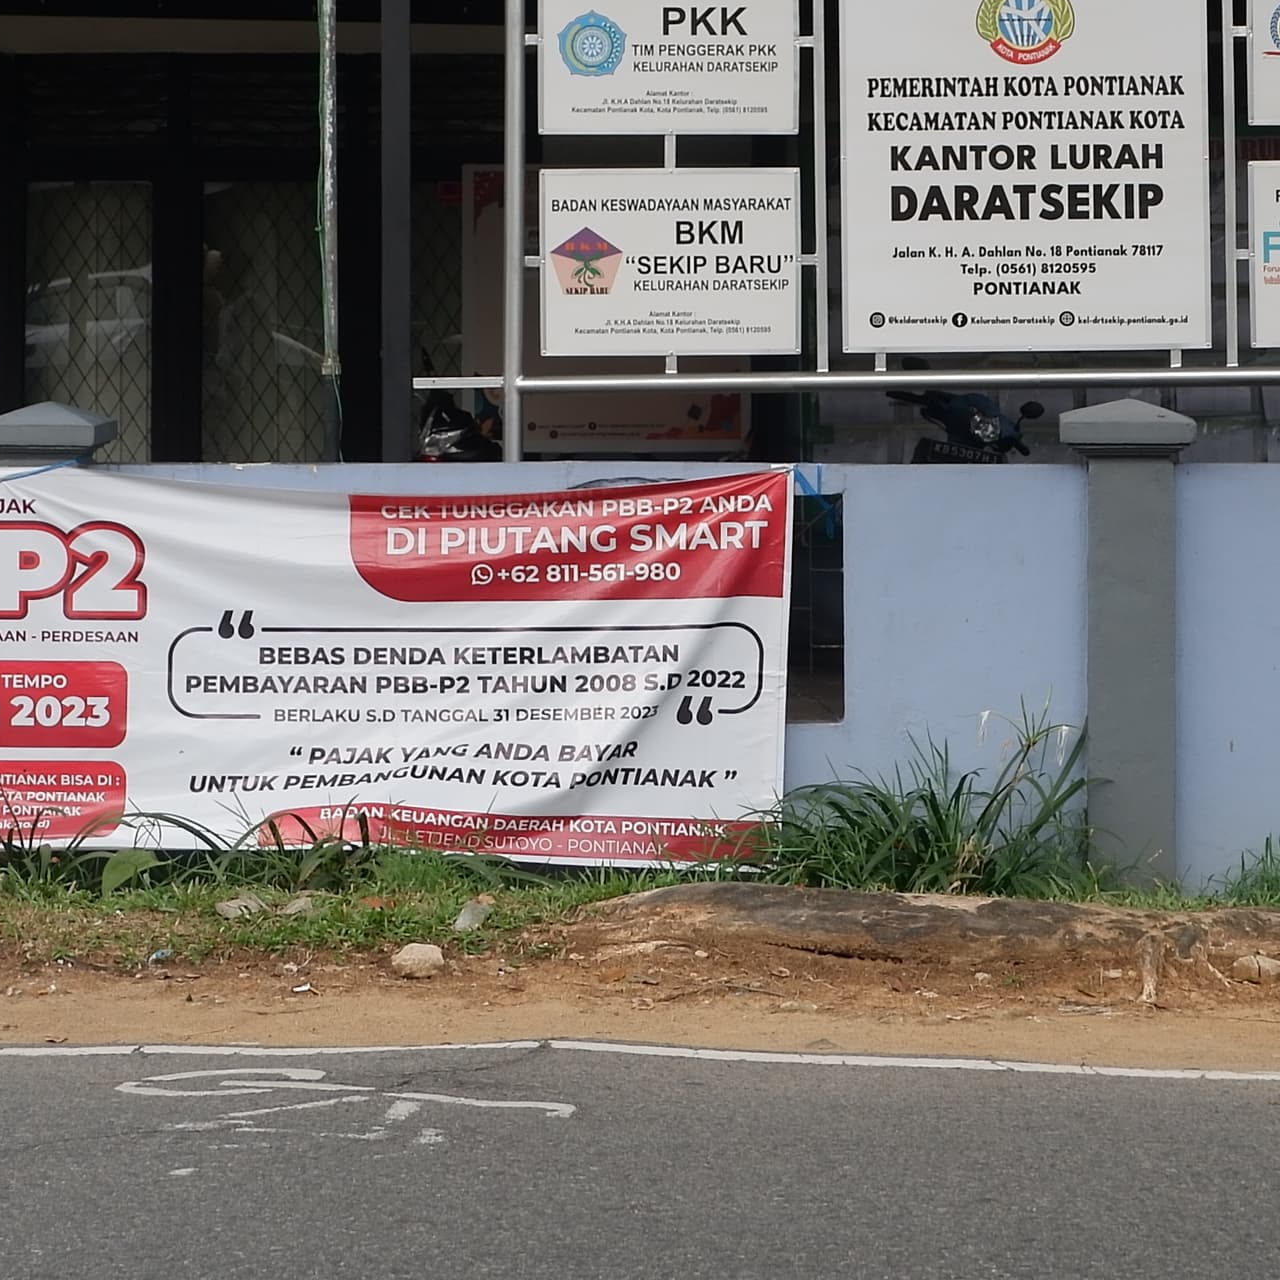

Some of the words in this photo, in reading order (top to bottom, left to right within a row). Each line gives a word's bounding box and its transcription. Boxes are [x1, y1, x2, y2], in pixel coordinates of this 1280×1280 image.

[662, 6, 747, 35] PKK
[631, 44, 654, 56] TIM
[658, 43, 744, 56] PENGGERAK
[748, 44, 776, 56] PKK
[867, 76, 998, 98] PEMERINTAH
[1003, 75, 1058, 97] KOTA
[1063, 75, 1184, 96] PONTIANAK
[867, 111, 996, 131] KECAMATAN
[1001, 110, 1124, 130] PONTIANAK
[1129, 109, 1185, 129] KOTA
[890, 144, 1036, 171] KANTOR
[1050, 143, 1163, 170] LURAH
[551, 199, 596, 212] BADAN
[601, 198, 699, 211] KESWADAYAAN
[703, 197, 791, 211] MASYARAKAT
[890, 183, 1163, 222] DARATSEKIP
[675, 220, 743, 245] BKM
[892, 246, 925, 258] Jalan
[928, 246, 941, 258] K.
[945, 245, 957, 257] H.
[961, 246, 974, 257] A.
[978, 245, 1021, 257] Dahlan
[1025, 245, 1046, 257] No.
[1049, 245, 1062, 256] 18
[1066, 244, 1127, 256] Pontianak
[1131, 244, 1163, 256] 78117
[960, 263, 991, 277] Telp.
[996, 262, 1036, 277] (0561)
[1040, 262, 1096, 274] 8120595
[973, 280, 1081, 295] PONTIANAK
[970, 315, 1011, 324] Kelurahan
[1012, 315, 1055, 326] Daratsekip
[379, 504, 430, 521] CEK
[437, 499, 594, 521] TUNGGAKAN
[601, 496, 693, 517] PBB-P2
[699, 493, 772, 514] ANDA
[386, 526, 425, 555] DI
[440, 522, 617, 556] PIUTANG
[630, 518, 768, 553] SMART
[497, 565, 539, 582] +62
[546, 561, 680, 584] 811-561-980
[41, 630, 138, 642] PERDESAAN
[259, 646, 345, 665] BEBAS
[353, 646, 446, 665] DENDA
[454, 644, 678, 665] KETERLAMBATAN
[0, 674, 67, 688] TEMPO
[185, 674, 366, 695] PEMBAYARAN
[376, 675, 469, 694] PBB-P2
[477, 675, 566, 693] TAHUN
[574, 674, 636, 692] 2008
[644, 672, 682, 691] S.D
[686, 670, 745, 689] 2022
[10, 695, 110, 727] 2023
[274, 708, 360, 723] BERLAKU
[366, 708, 395, 722] S.D
[400, 708, 488, 722] TANGGAL
[493, 708, 509, 722] 31
[515, 706, 615, 721] DESEMBER
[621, 704, 659, 719] 2023
[308, 746, 393, 765] PAJAK
[401, 743, 468, 763] YANG
[473, 742, 549, 763] ANDA
[558, 740, 638, 762] BAYAR
[60, 774, 93, 785] BISA
[97, 774, 111, 786] DI
[189, 774, 278, 793] UNTUK
[283, 770, 485, 790] PEMBANGUNAN
[492, 769, 560, 789] KOTA
[569, 767, 717, 789] PONTIANAK
